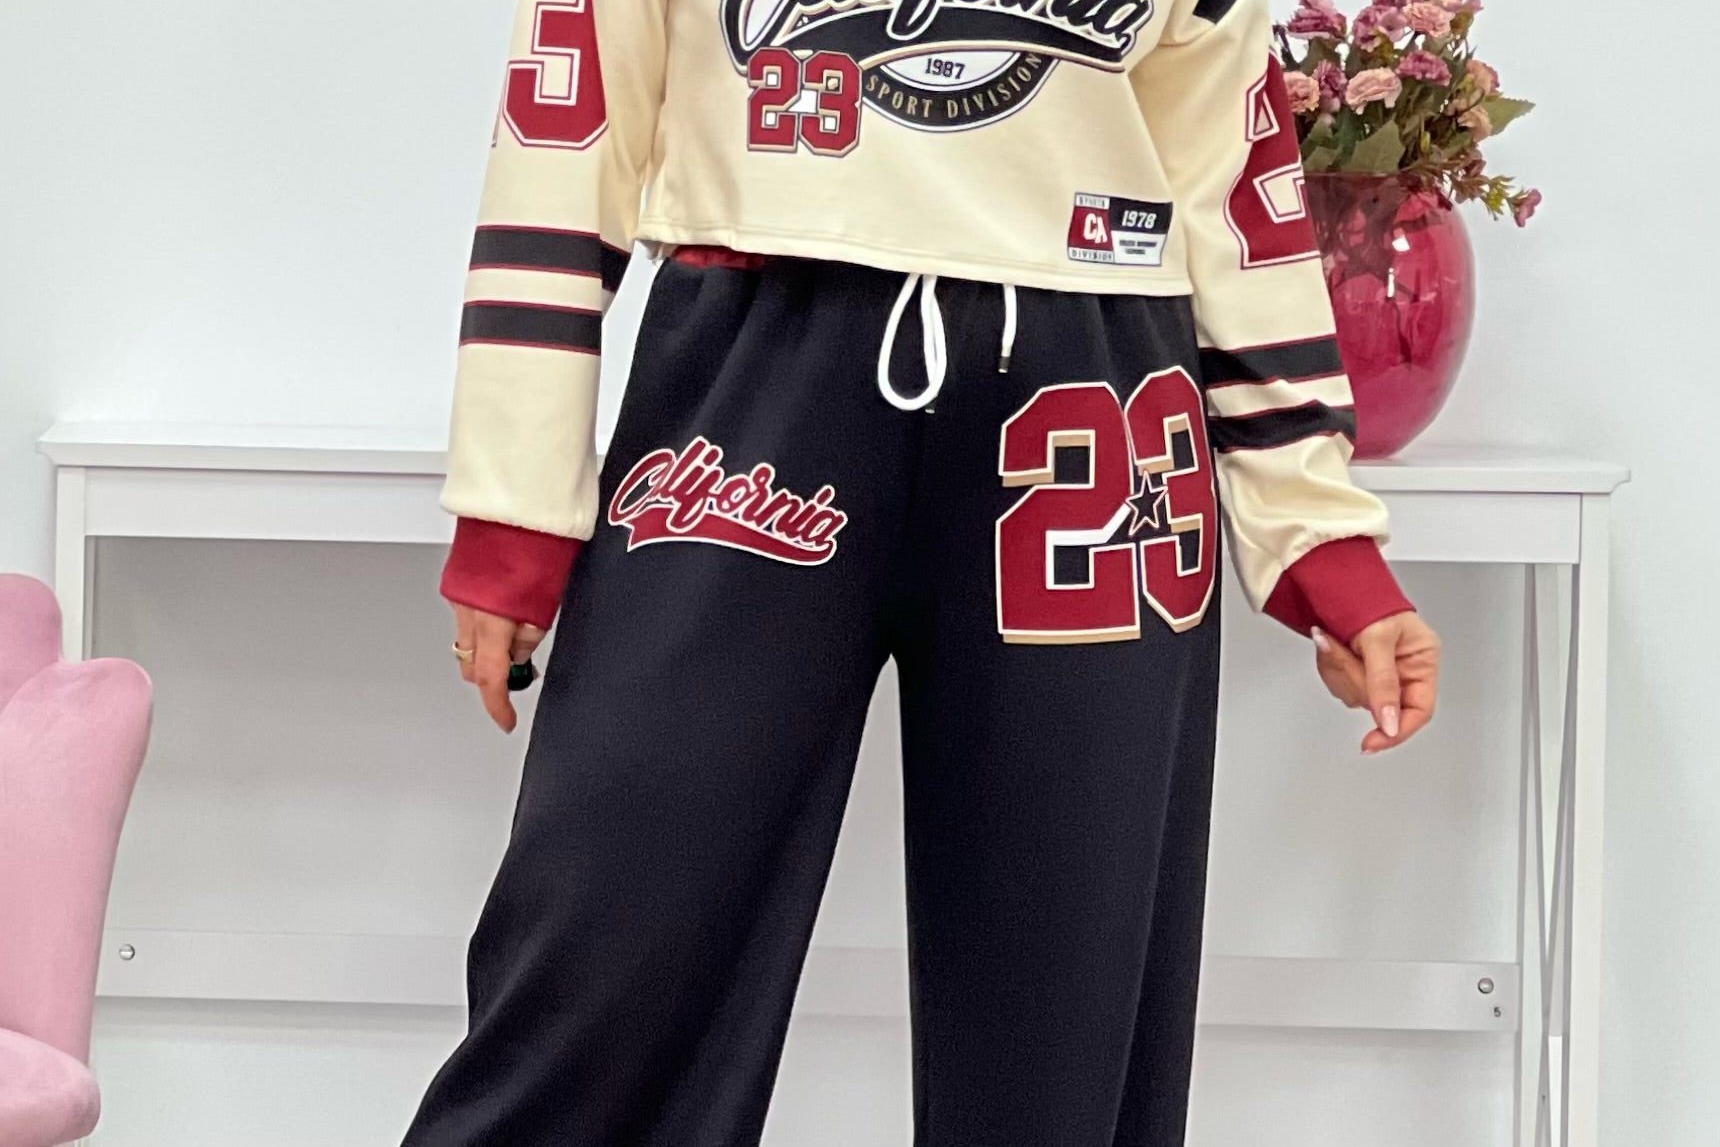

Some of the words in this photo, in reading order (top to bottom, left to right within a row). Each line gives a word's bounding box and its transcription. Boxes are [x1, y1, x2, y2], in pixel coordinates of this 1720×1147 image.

[866, 75, 932, 118] SPORT
[947, 53, 1042, 118] DIVISION
[925, 58, 965, 80] 1987
[747, 47, 863, 158] 23
[1083, 213, 1108, 244] CA
[1121, 210, 1157, 229] 1978
[996, 366, 1216, 643] 23
